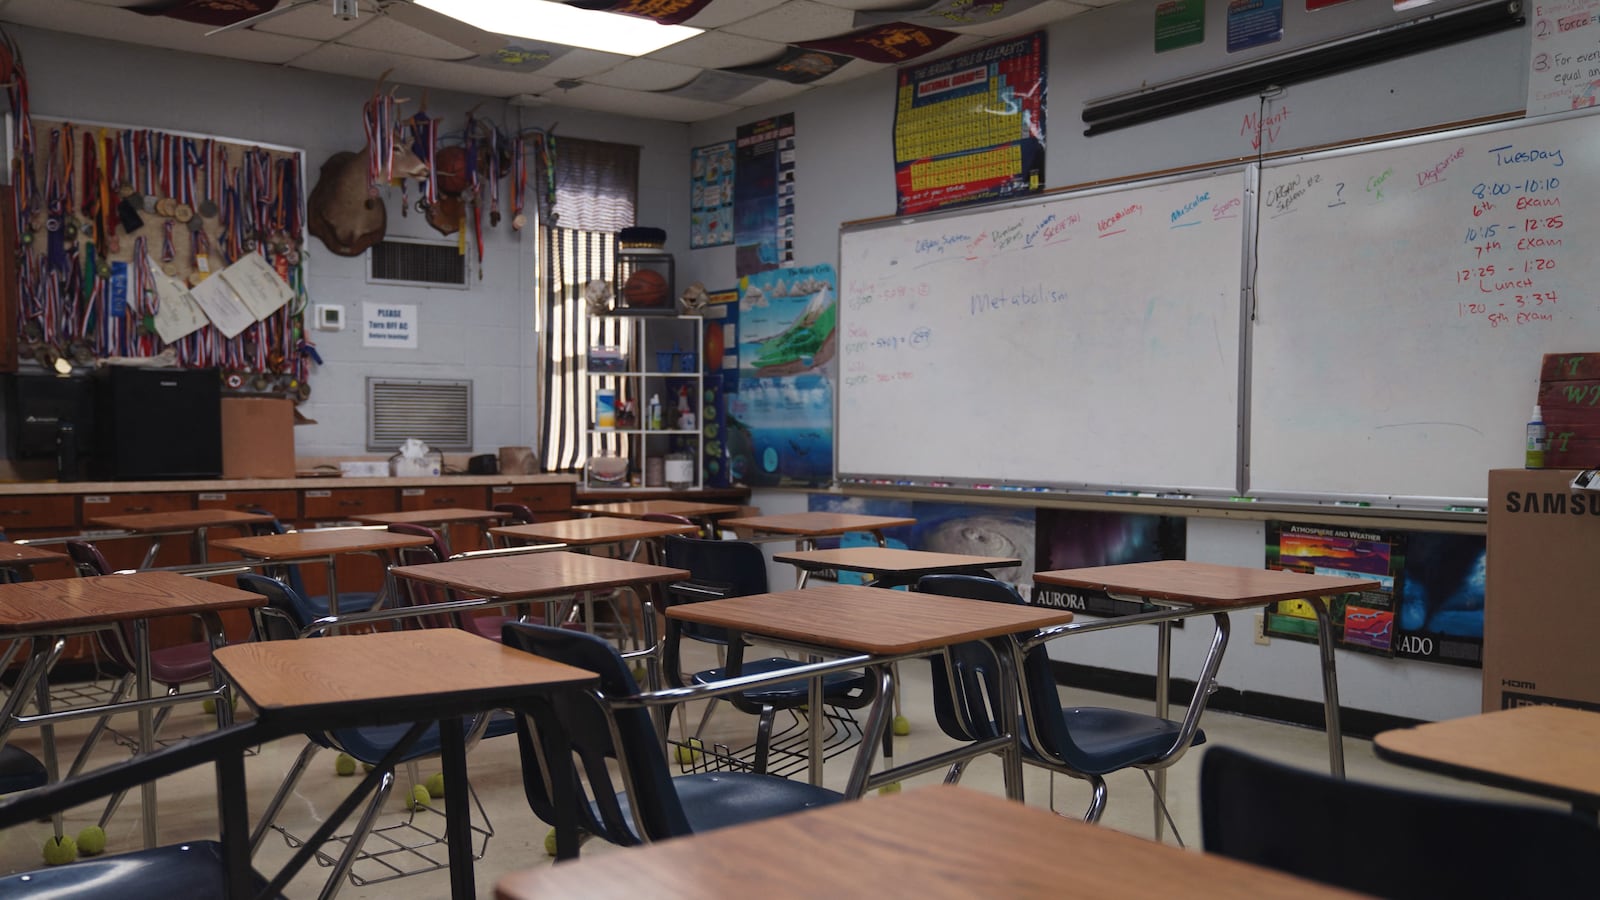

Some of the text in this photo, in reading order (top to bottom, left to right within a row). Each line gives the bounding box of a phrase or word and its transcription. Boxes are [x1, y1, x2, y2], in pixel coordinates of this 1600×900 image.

[1524, 215, 1564, 232] 12:25
[1457, 265, 1495, 283] 12:25
[1524, 259, 1556, 272] 1:20
[378, 309, 401, 318] PLEASE
[1458, 303, 1486, 318] 1:20
[1036, 590, 1086, 611] AURORA
